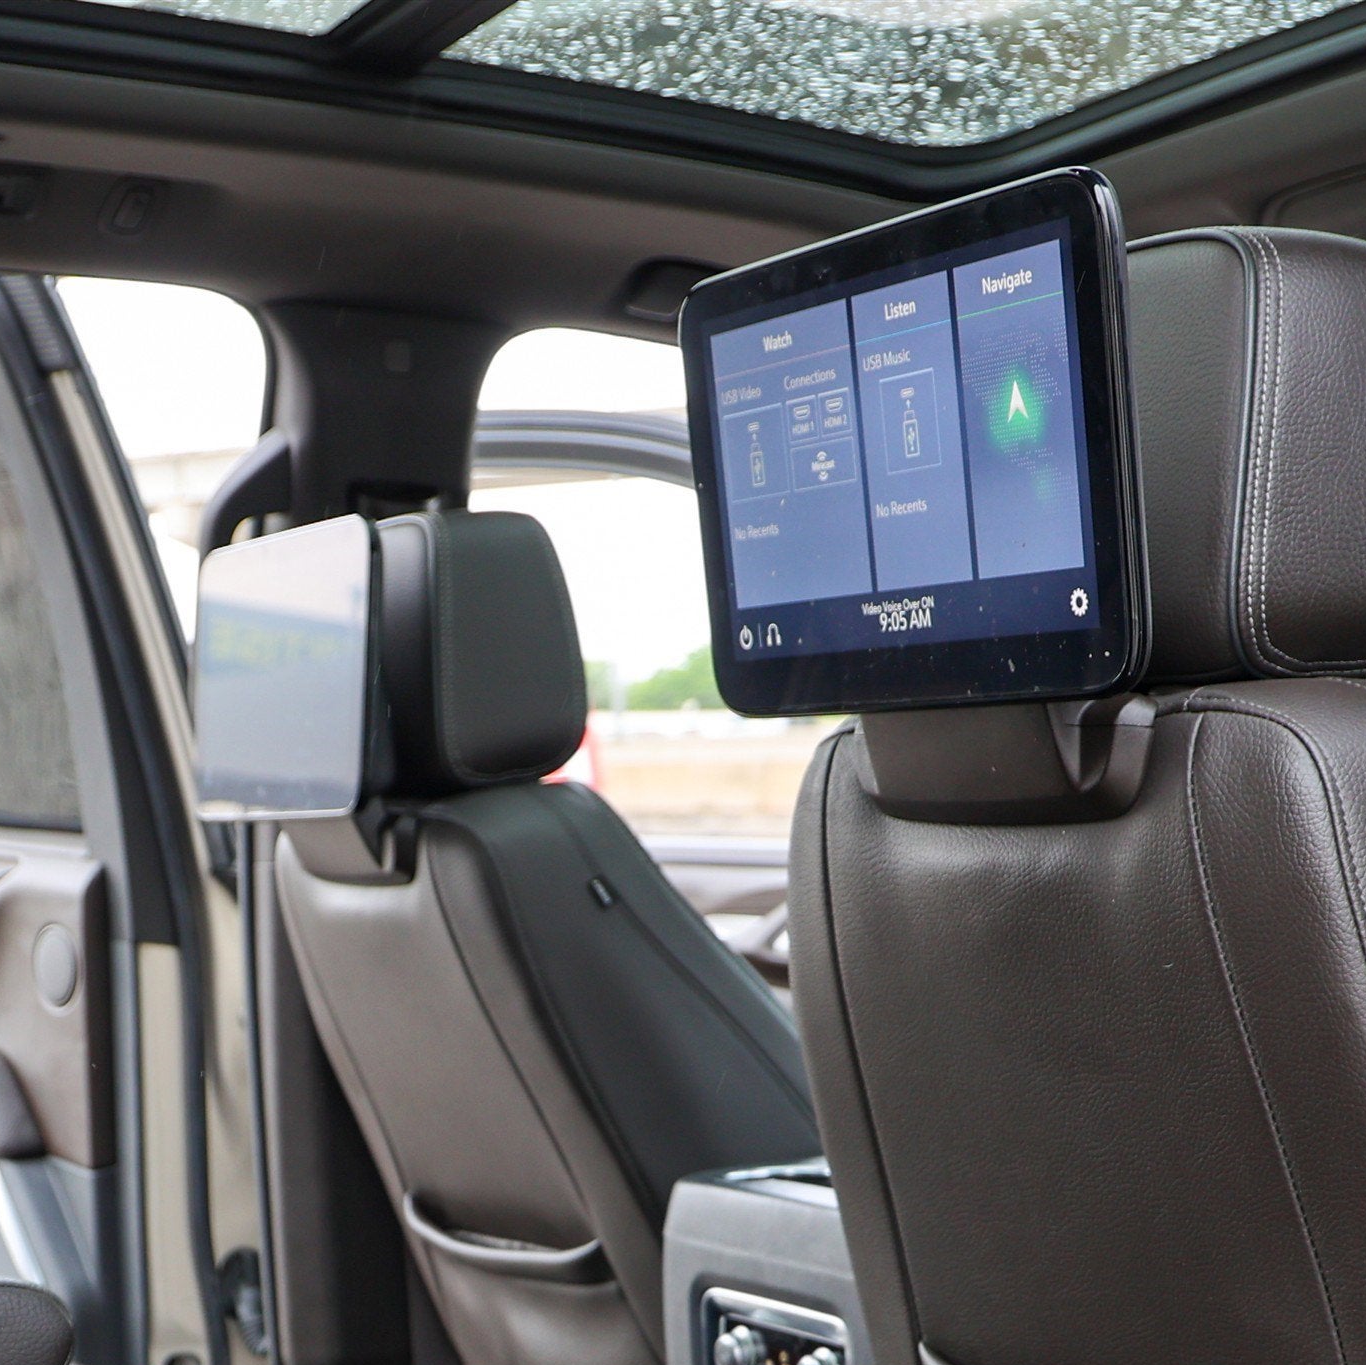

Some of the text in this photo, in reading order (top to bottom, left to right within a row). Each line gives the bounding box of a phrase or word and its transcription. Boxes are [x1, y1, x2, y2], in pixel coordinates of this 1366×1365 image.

[981, 268, 1033, 295] Navigate
[884, 300, 917, 321] Listen
[762, 330, 793, 353] Watch
[863, 348, 911, 372] USB Music
[783, 368, 837, 390] Connections
[721, 384, 762, 405] USB Video
[792, 423, 810, 435] HDMI
[824, 416, 842, 428] HDMI
[876, 498, 928, 518] No Recents
[735, 523, 780, 540] No Recents
[861, 595, 935, 616] Video Voice Over ON
[879, 608, 932, 632] 9:05 AM
